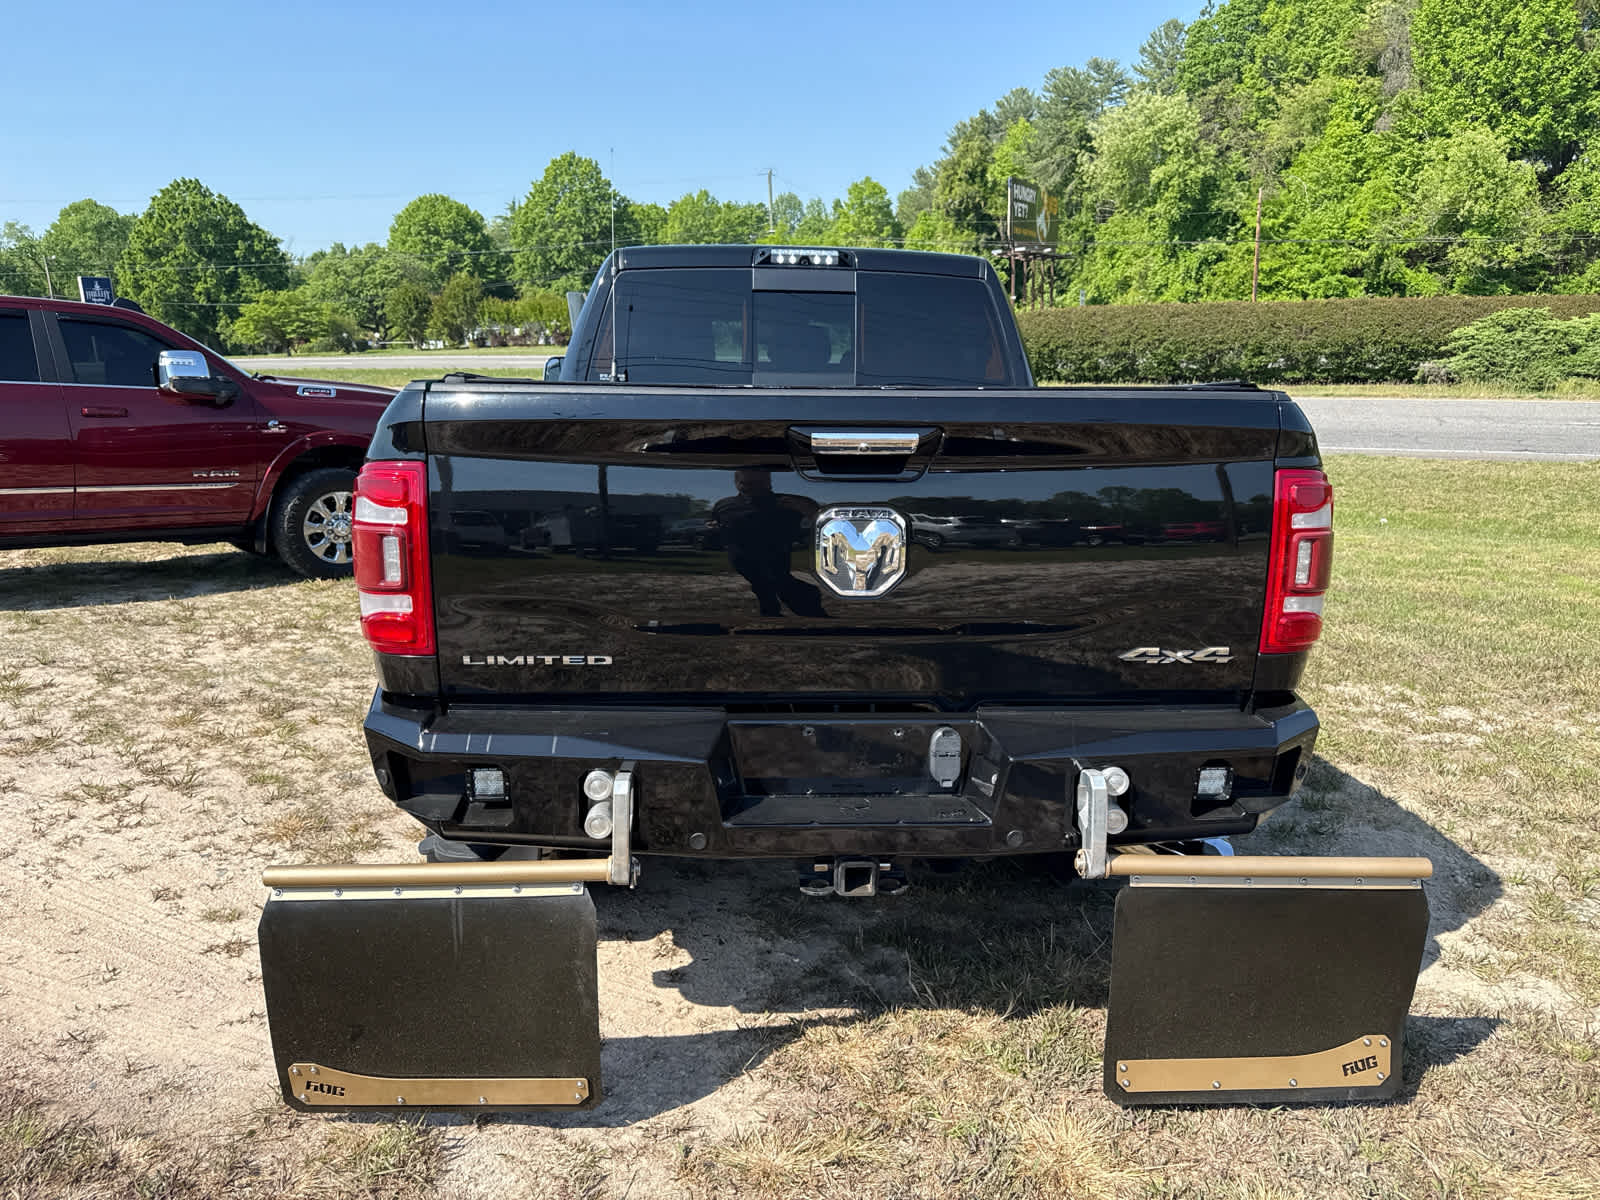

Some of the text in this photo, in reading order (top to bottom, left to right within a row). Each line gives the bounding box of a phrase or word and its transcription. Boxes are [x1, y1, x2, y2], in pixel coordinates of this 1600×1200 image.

[1013, 183, 1036, 204] HUNGRY
[831, 509, 889, 519] RAM
[462, 655, 613, 665] LIMITED
